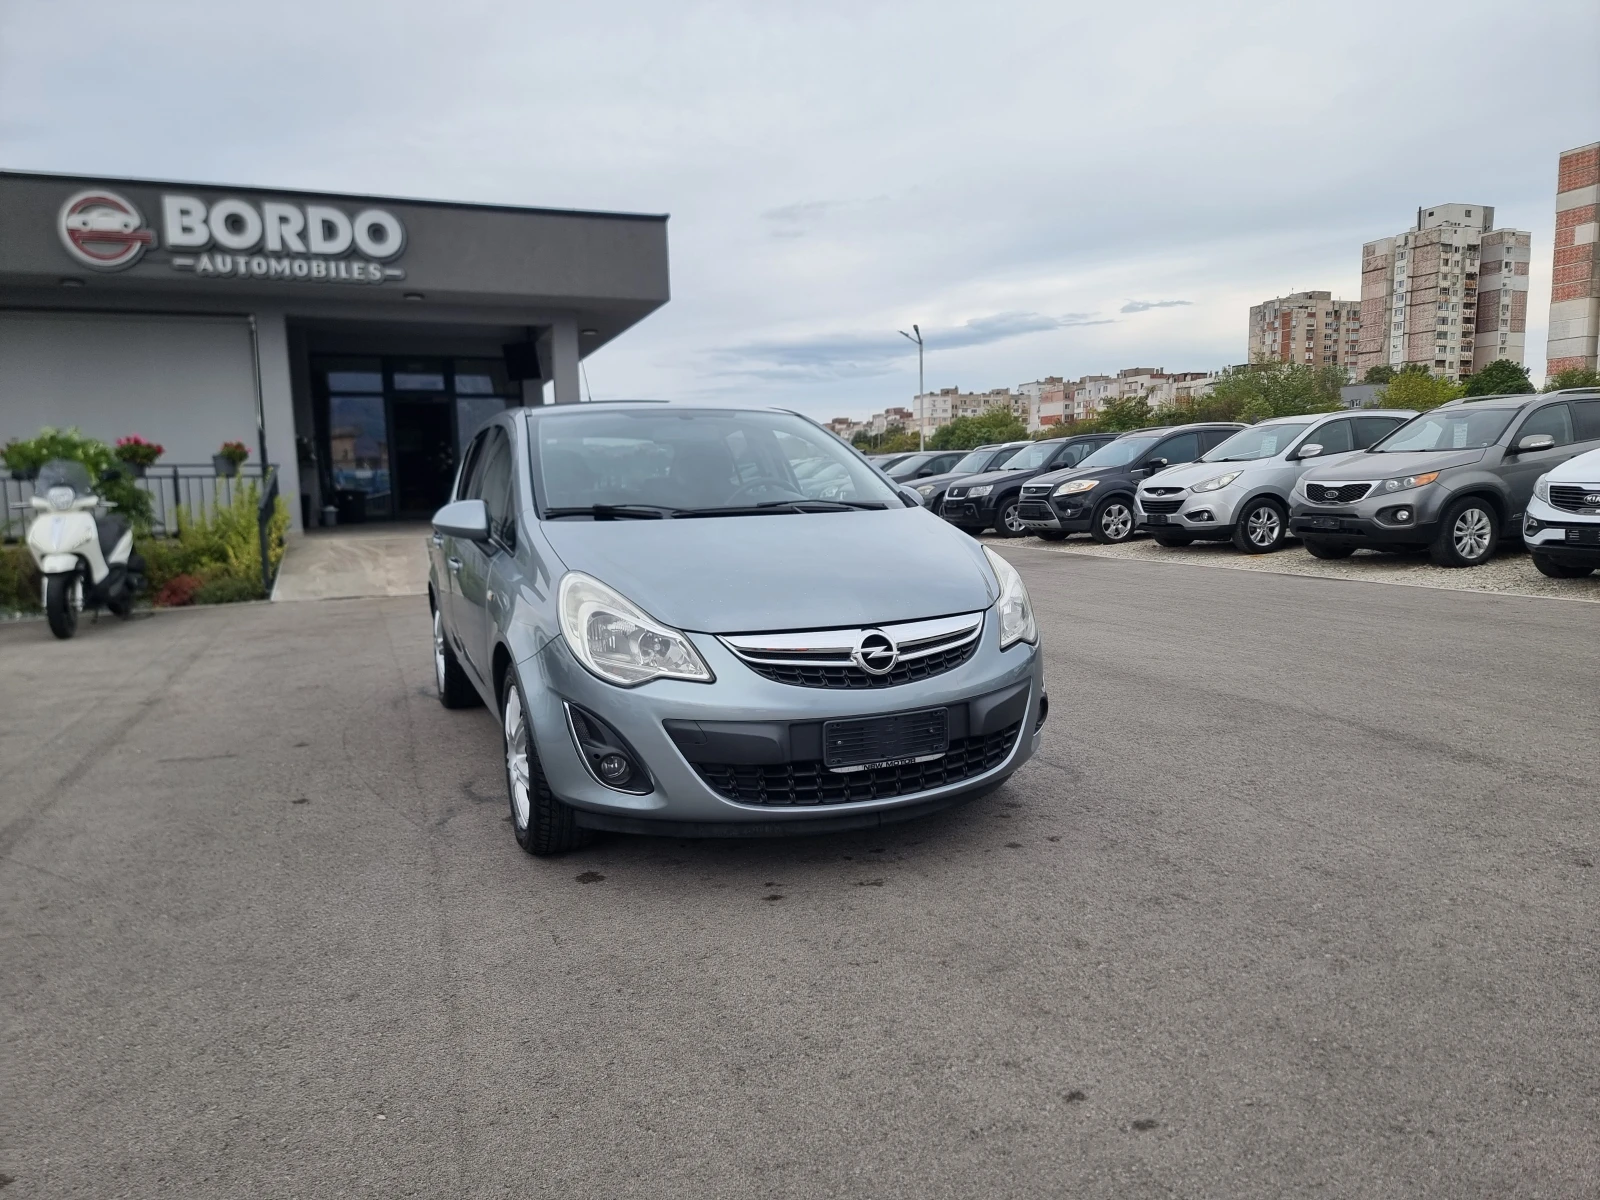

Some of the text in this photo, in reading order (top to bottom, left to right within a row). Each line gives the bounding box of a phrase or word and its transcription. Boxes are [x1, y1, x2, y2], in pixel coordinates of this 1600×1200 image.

[163, 195, 402, 258] BORDO
[199, 254, 382, 280] AUTOMOBILES
[863, 757, 916, 771] NEW MOTOR
